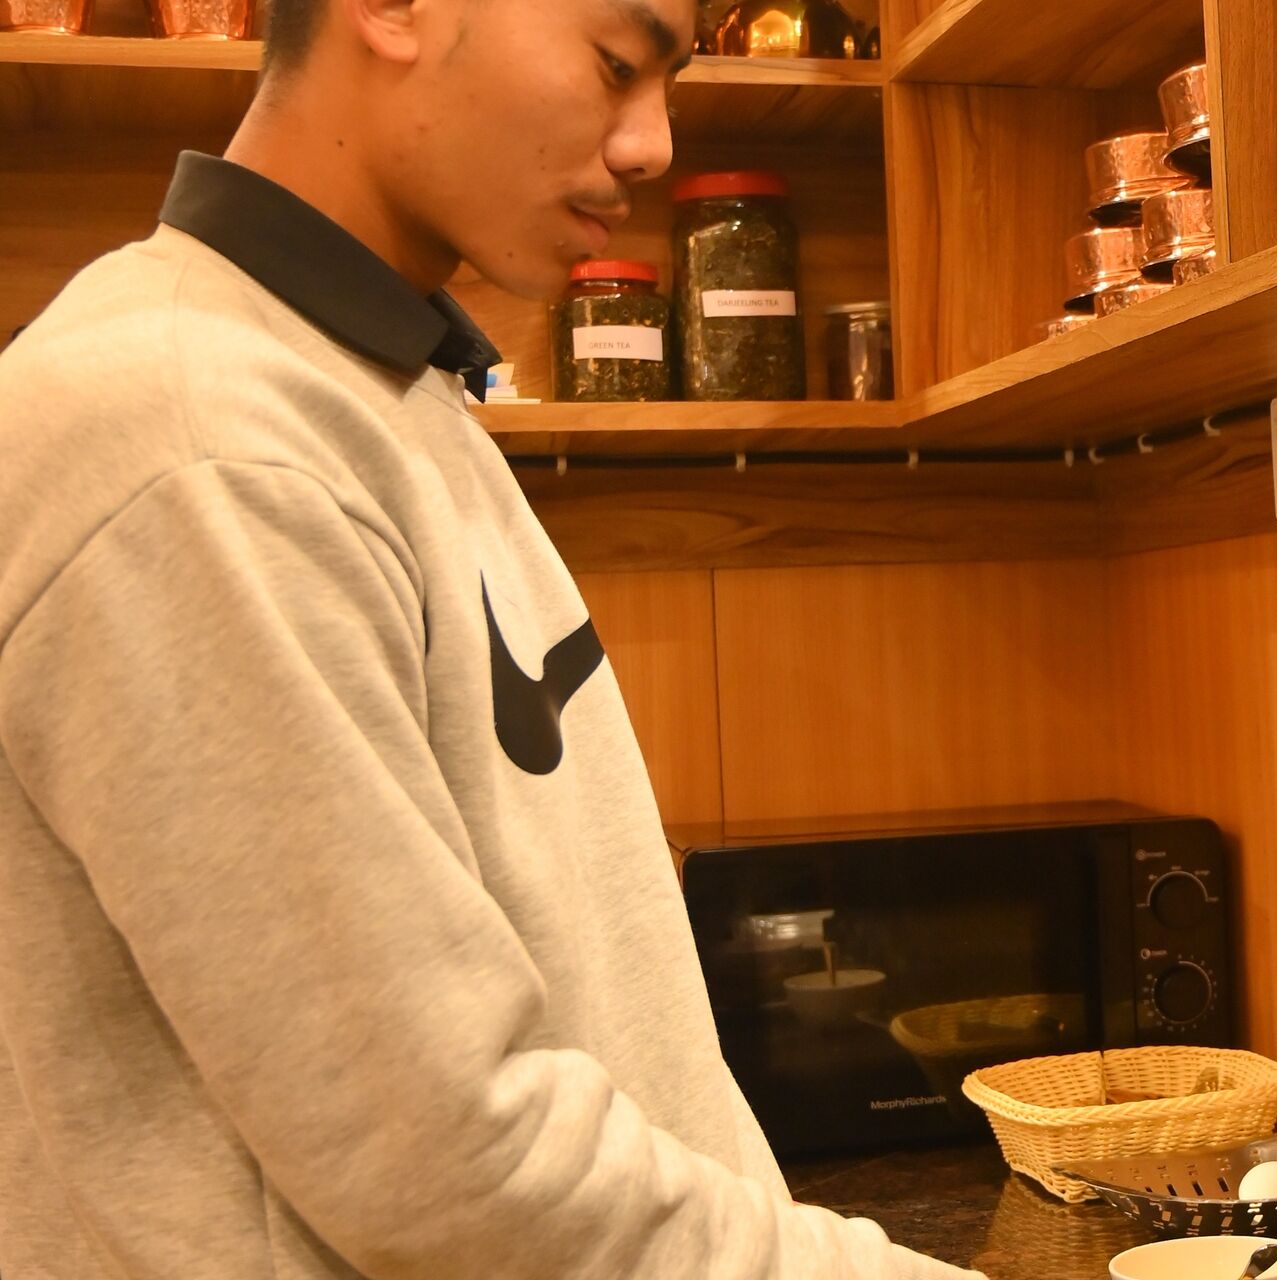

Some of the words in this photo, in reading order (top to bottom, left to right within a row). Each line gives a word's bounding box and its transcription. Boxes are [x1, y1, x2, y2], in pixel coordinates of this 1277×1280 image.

[717, 299, 763, 307] DARJEELING
[764, 299, 779, 307] TEA
[588, 341, 614, 350] GREEN
[616, 341, 632, 350] TEA
[870, 1094, 947, 1110] MorphyRichards
